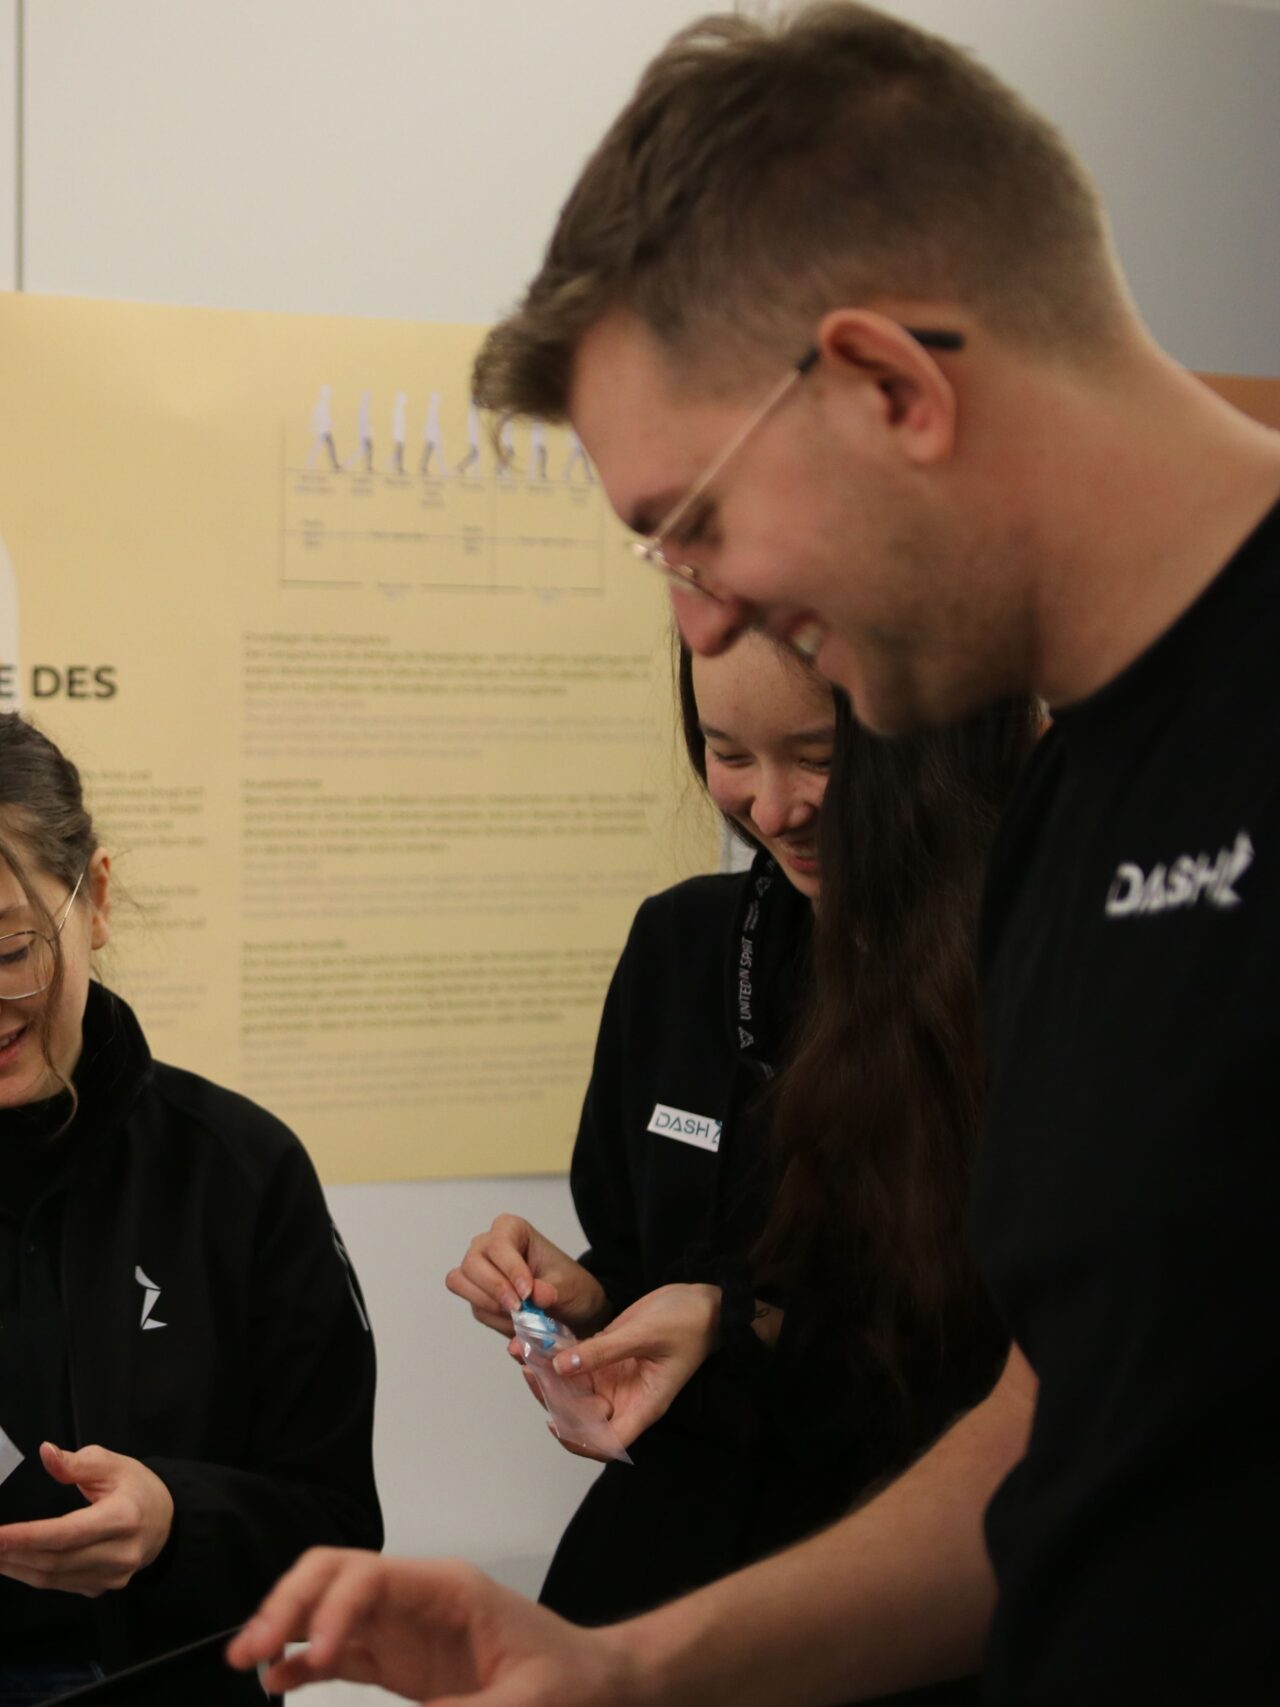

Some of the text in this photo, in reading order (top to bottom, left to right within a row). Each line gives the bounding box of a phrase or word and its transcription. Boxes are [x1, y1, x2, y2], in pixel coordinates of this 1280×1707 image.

[31, 665, 118, 700] DES
[1104, 850, 1232, 918] DASH
[739, 980, 752, 1020] UNITED
[655, 1110, 710, 1139] DASH
